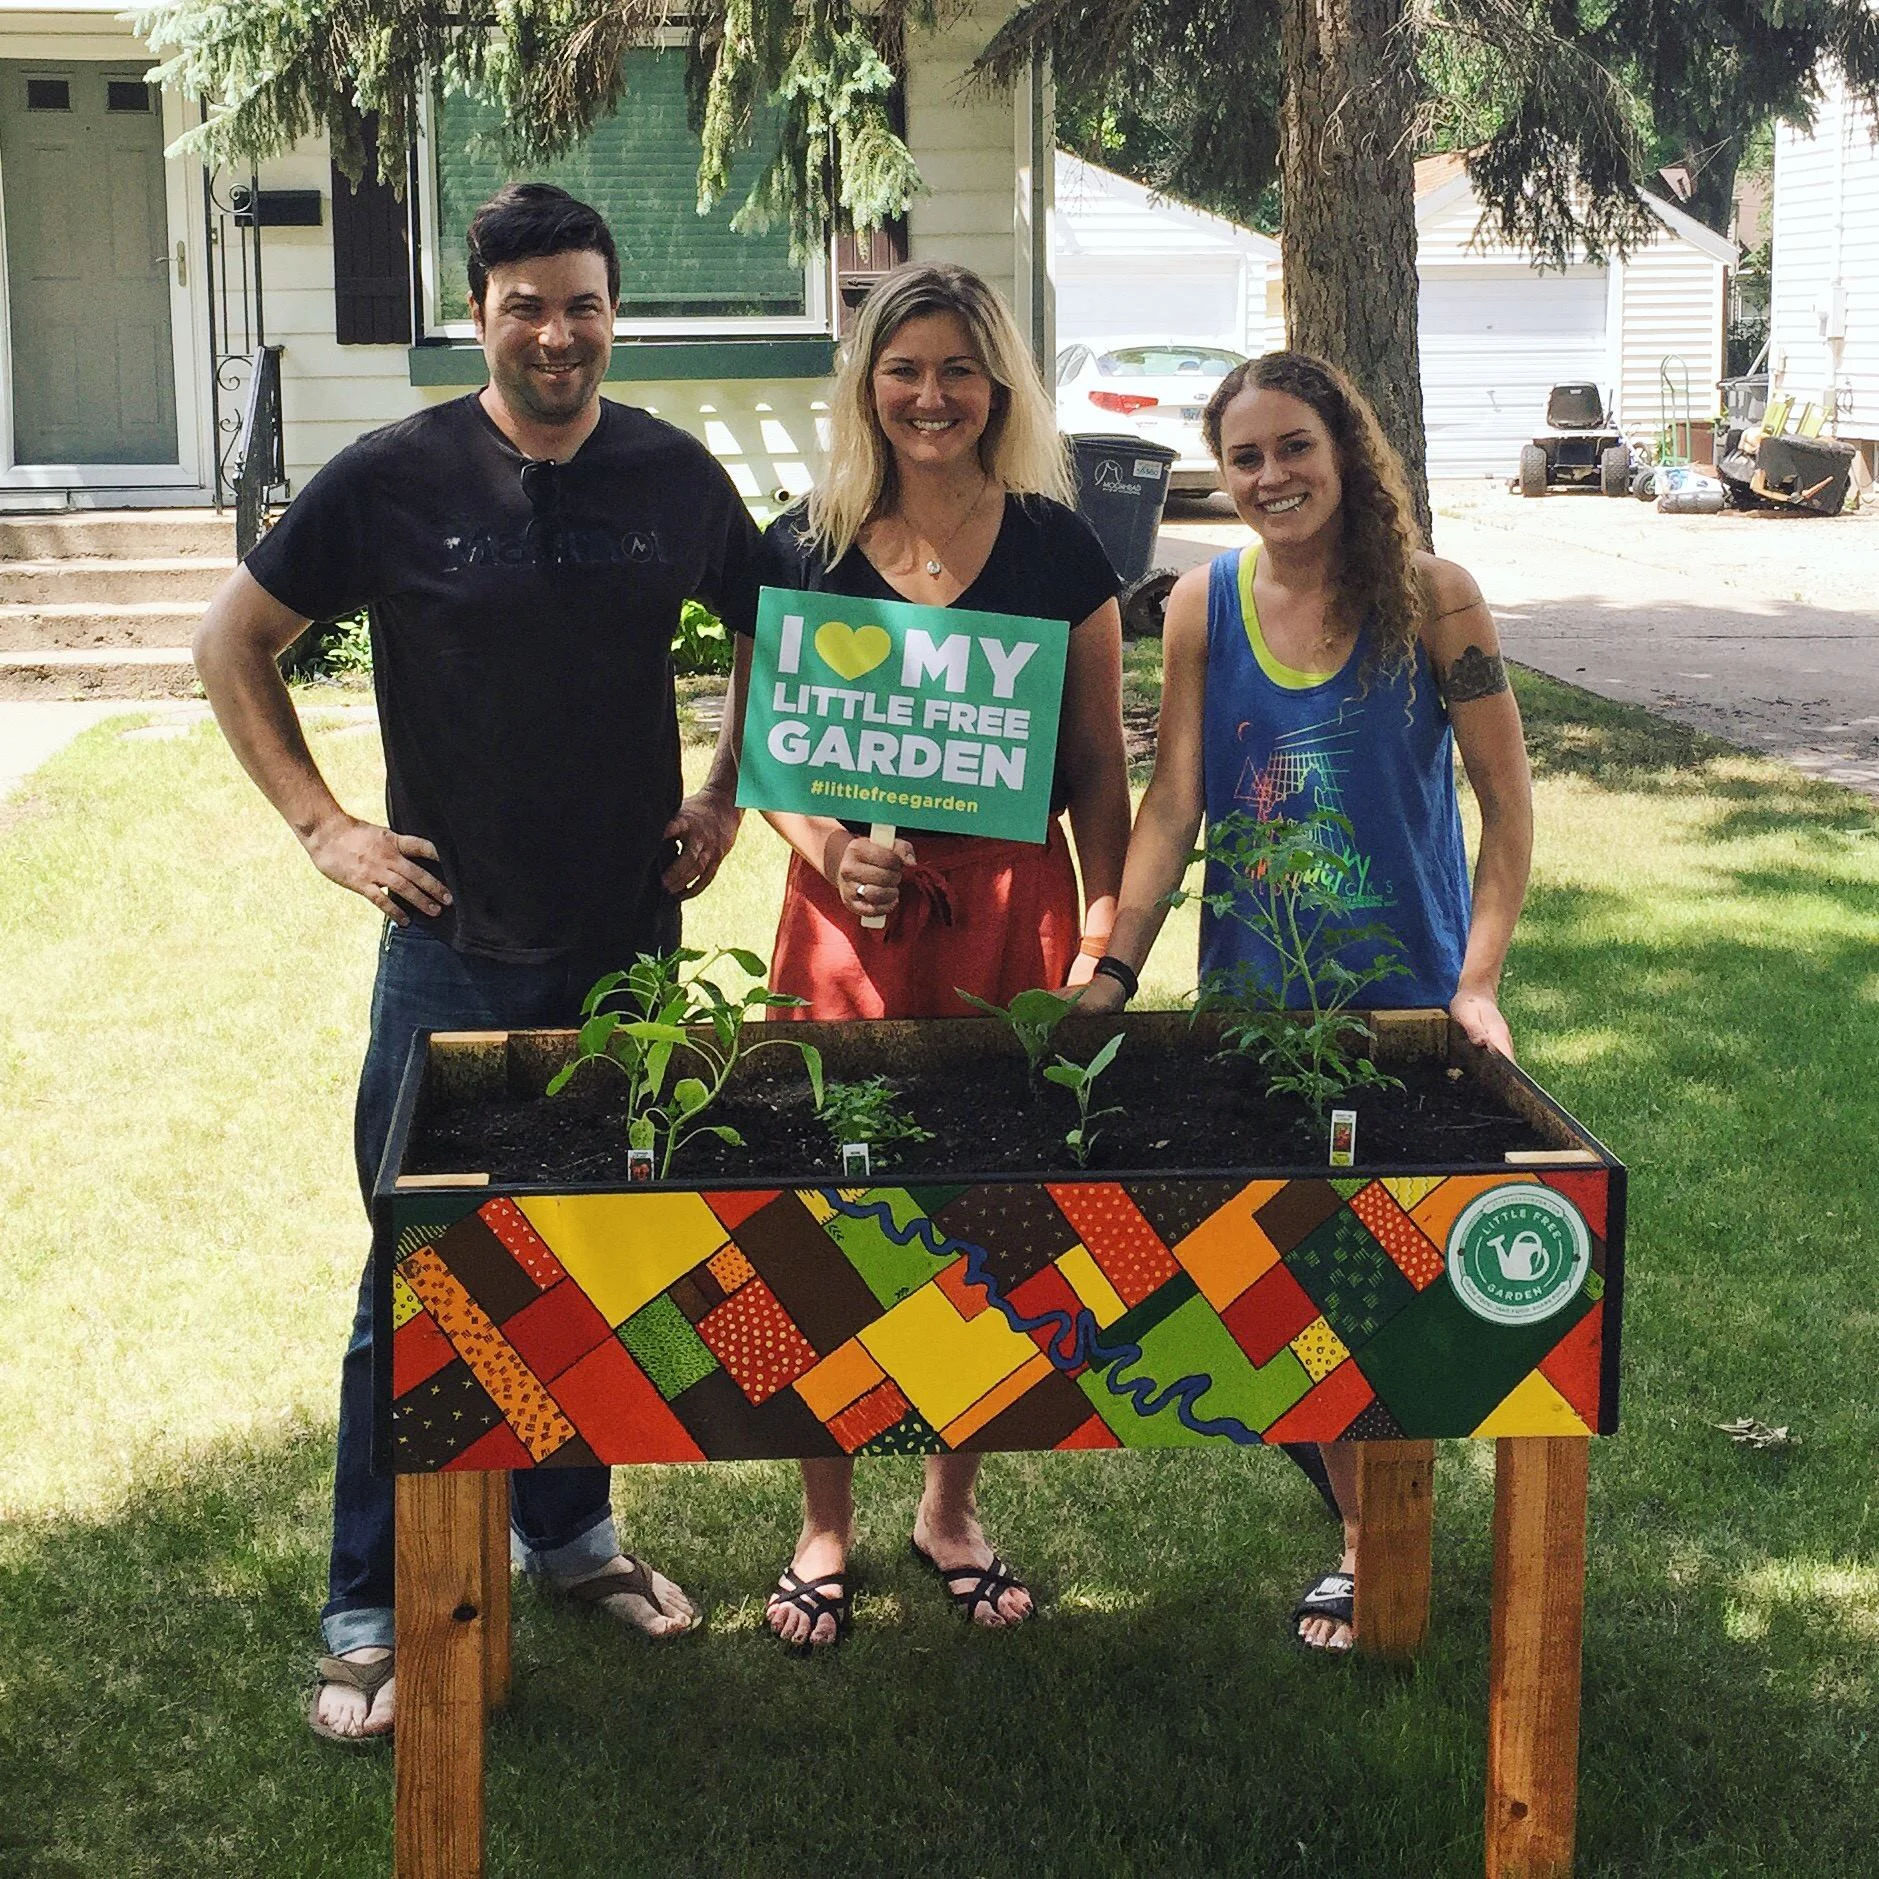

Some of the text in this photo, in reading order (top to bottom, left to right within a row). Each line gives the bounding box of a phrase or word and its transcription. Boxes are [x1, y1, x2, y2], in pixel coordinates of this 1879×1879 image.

[777, 614, 1040, 699] I MY
[773, 682, 1031, 740] LITTLE FREE
[767, 720, 1027, 791] GARDEN
[811, 780, 978, 813] #littlefreegarden
[1481, 1209, 1562, 1240] LITTLE FREE
[1487, 1283, 1543, 1301] GARDEN
